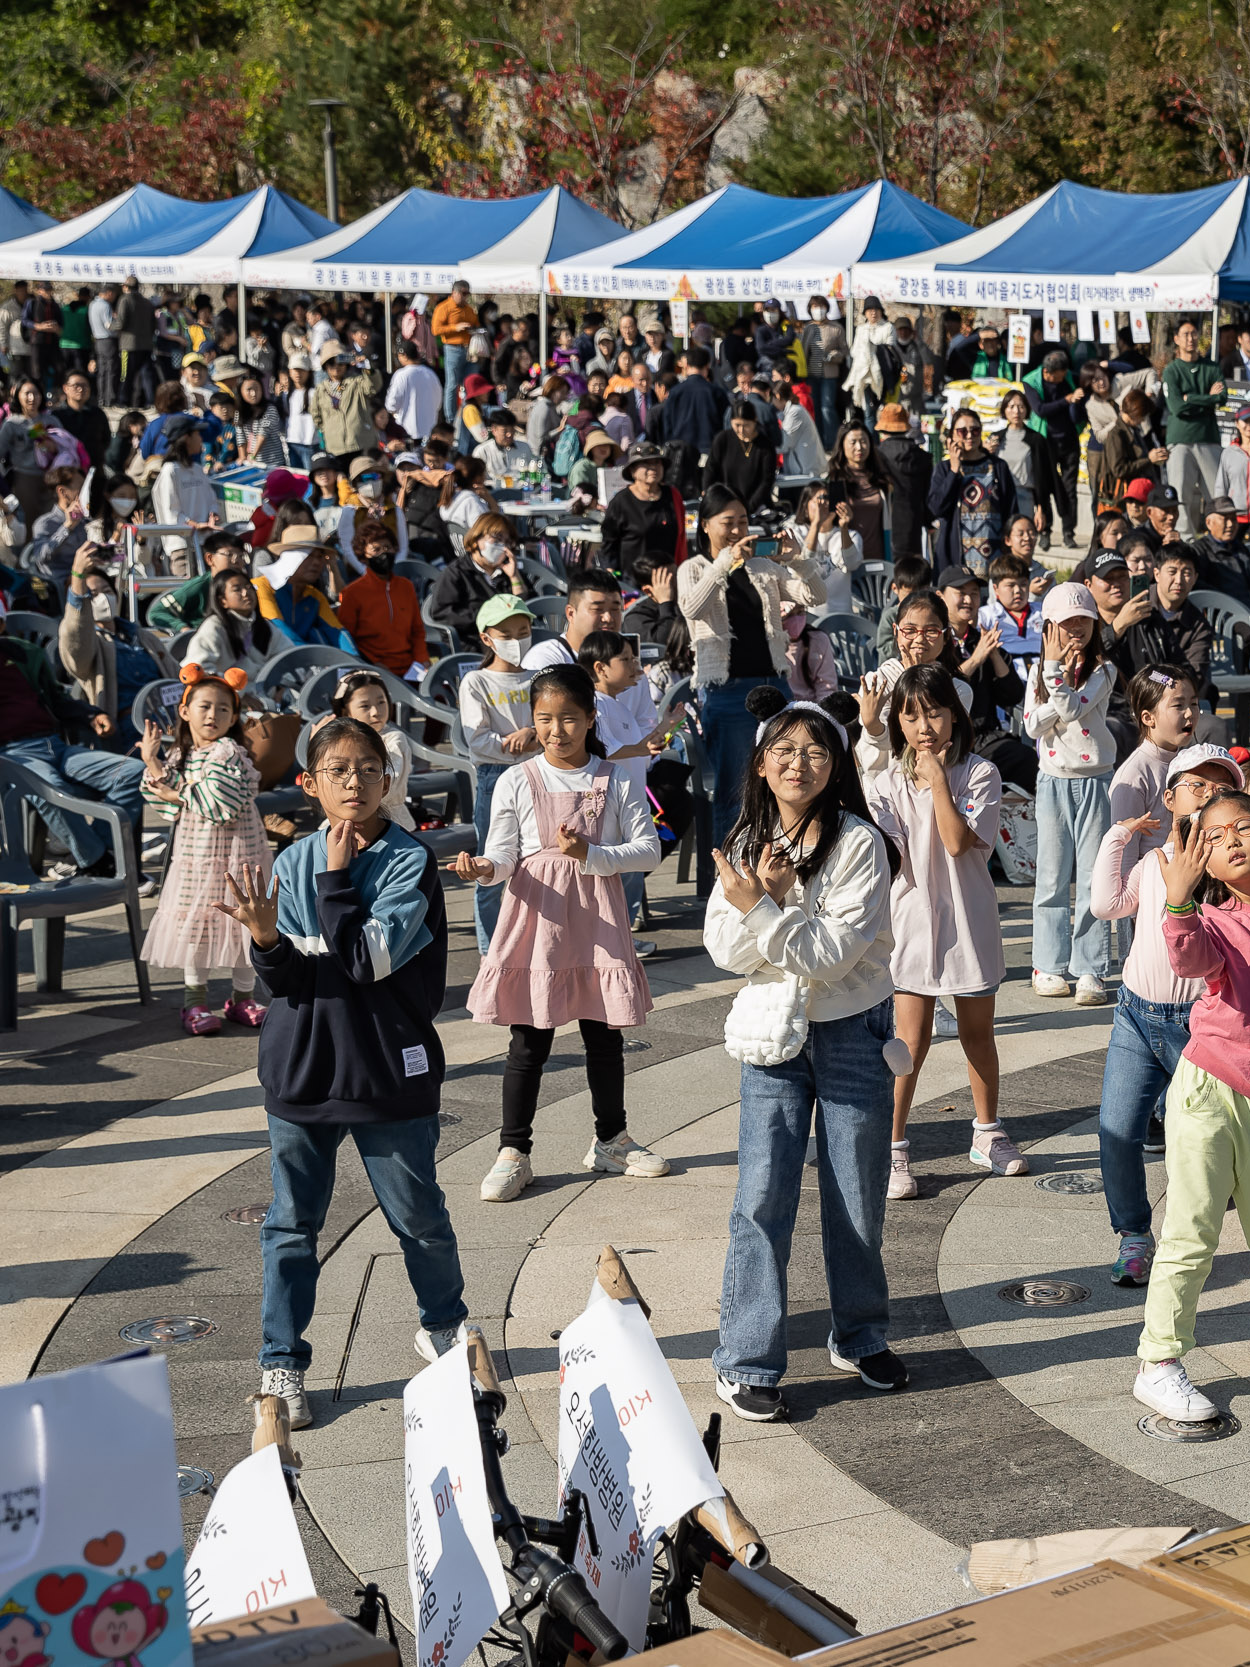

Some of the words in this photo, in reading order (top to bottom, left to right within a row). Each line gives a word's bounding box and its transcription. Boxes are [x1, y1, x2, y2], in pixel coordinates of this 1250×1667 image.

[706, 277, 735, 295] 광장동
[742, 277, 772, 297] 상인회
[900, 277, 930, 298] 광장동
[935, 279, 967, 298] 체육회
[976, 280, 1081, 304] 새마을지도자협의회
